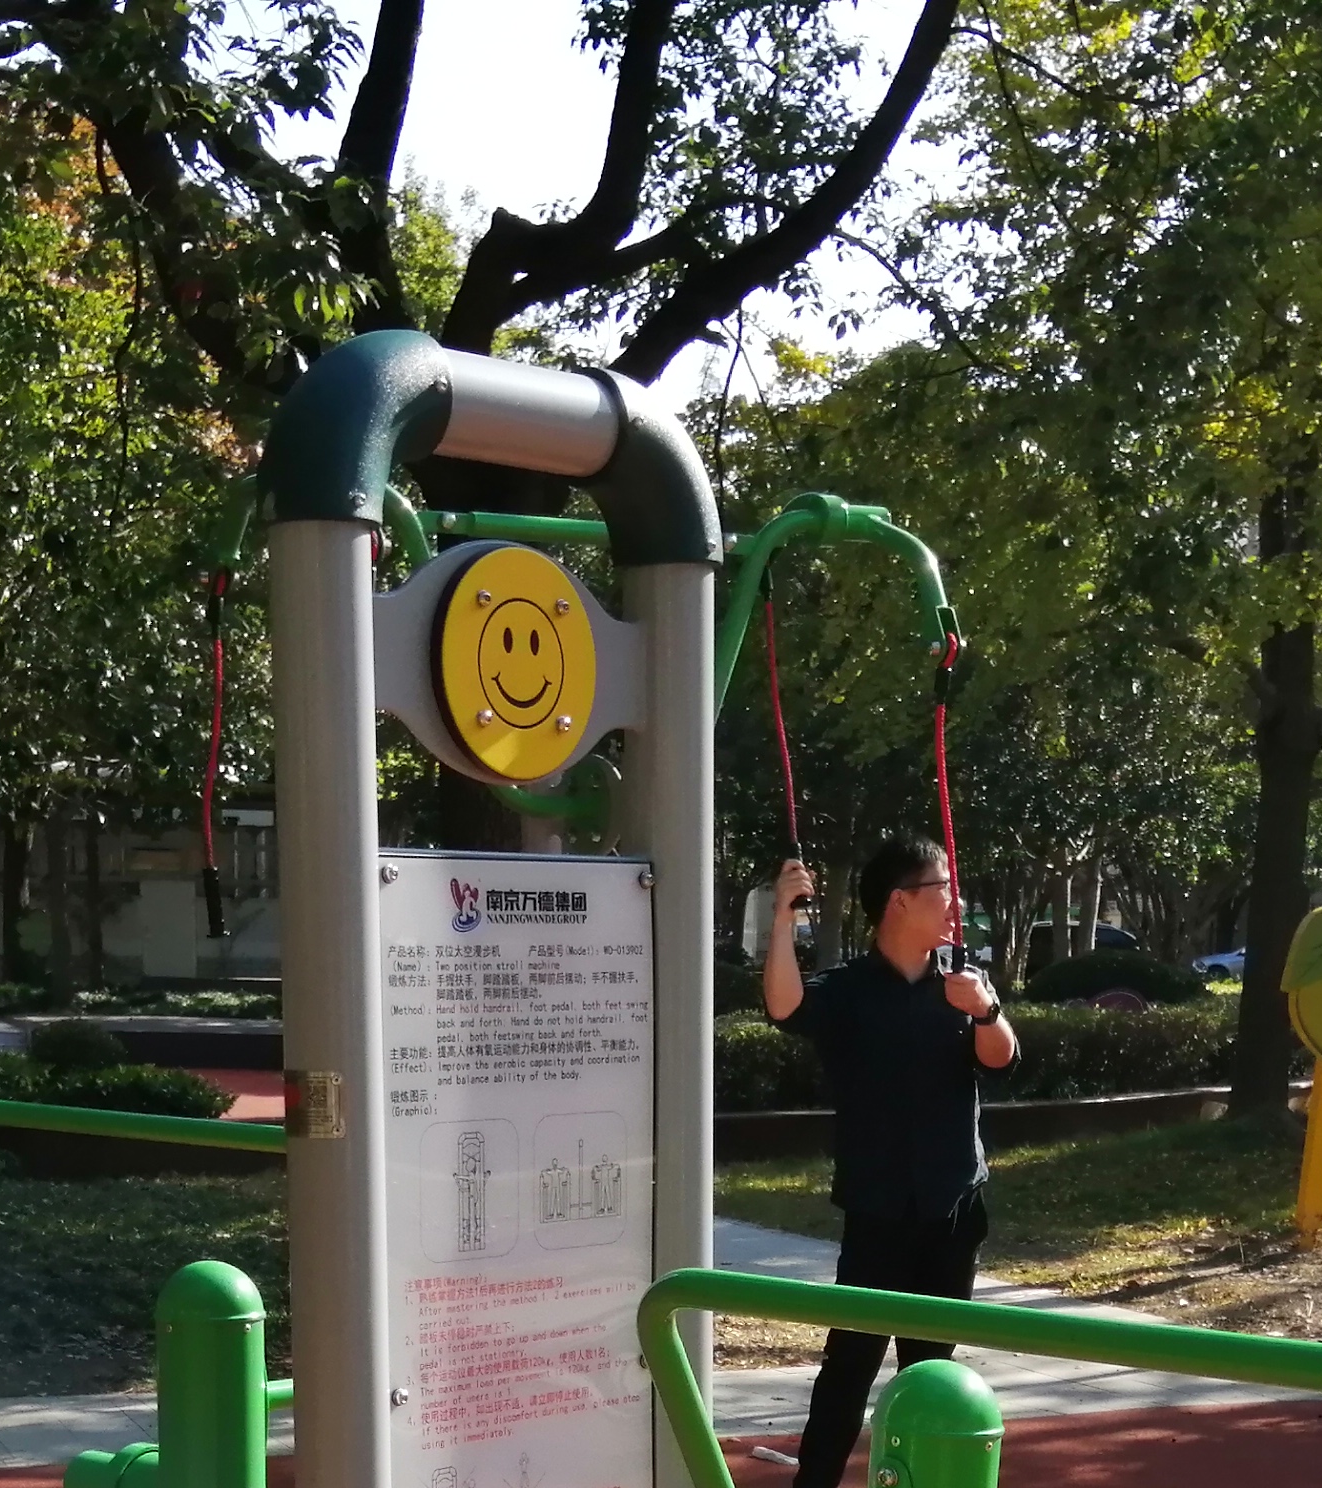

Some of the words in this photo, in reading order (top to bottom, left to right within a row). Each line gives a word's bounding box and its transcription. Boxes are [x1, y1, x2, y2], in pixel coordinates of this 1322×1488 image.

[486, 889, 587, 912] 南京万德集团
[486, 914, 587, 925] NANJINGWANDEGROUP
[435, 945, 501, 958] 双位太空漫步机
[436, 961, 451, 971] Two
[454, 961, 493, 972] position
[496, 960, 523, 971] stroll
[528, 961, 560, 970] machine
[436, 1004, 456, 1014] Hand
[460, 1004, 479, 1014] hold
[529, 1001, 547, 1012] foot
[582, 1001, 601, 1011] both
[605, 1000, 621, 1010] feet
[626, 1001, 648, 1011] swing
[437, 1018, 456, 1029] back
[460, 1018, 475, 1028] and
[511, 1016, 529, 1026] Hand
[534, 1016, 543, 1026] do
[547, 1016, 561, 1026] not
[565, 1015, 584, 1025] hold
[631, 1013, 648, 1023] foot
[469, 1032, 489, 1042] both
[538, 1029, 557, 1040] back
[561, 1029, 575, 1039] and
[439, 1061, 471, 1072] Improve
[475, 1060, 489, 1070] the
[493, 1058, 526, 1069] aerobic
[530, 1058, 565, 1069] capacity
[570, 1056, 584, 1066] and
[588, 1054, 640, 1065] coordination
[437, 1075, 453, 1086] and
[456, 1074, 489, 1085] balance
[493, 1073, 526, 1084] ability
[530, 1071, 539, 1081] of
[544, 1070, 557, 1081] the
[419, 1306, 442, 1317] After
[446, 1301, 489, 1313] mastering
[493, 1298, 506, 1308] the
[510, 1295, 537, 1305] method
[563, 1287, 602, 1300] exercises
[605, 1283, 623, 1293] will
[627, 1282, 636, 1292] be
[419, 1317, 452, 1330] carried
[420, 1347, 429, 1358] It
[434, 1345, 443, 1356] is
[447, 1338, 489, 1353] forbidden
[493, 1338, 503, 1348] to
[519, 1335, 529, 1345] up
[532, 1331, 546, 1342] and
[549, 1329, 569, 1339] down
[572, 1326, 590, 1336] when
[593, 1323, 606, 1333] the
[419, 1358, 442, 1371] pedal
[448, 1357, 457, 1367] is
[461, 1355, 475, 1365] not
[420, 1387, 435, 1397] The
[438, 1383, 472, 1394] maximum
[476, 1378, 494, 1389] load
[497, 1377, 511, 1387] per
[597, 1361, 611, 1371] and
[420, 1400, 448, 1411] number
[452, 1395, 462, 1406] of
[466, 1393, 490, 1404] users
[494, 1389, 503, 1399] is
[422, 1427, 431, 1437] If
[435, 1424, 459, 1435] there
[463, 1420, 472, 1430] is
[475, 1419, 489, 1430] any
[493, 1410, 538, 1426] discomfort
[542, 1405, 569, 1417] during
[421, 1439, 446, 1451] using
[450, 1435, 458, 1446] it
